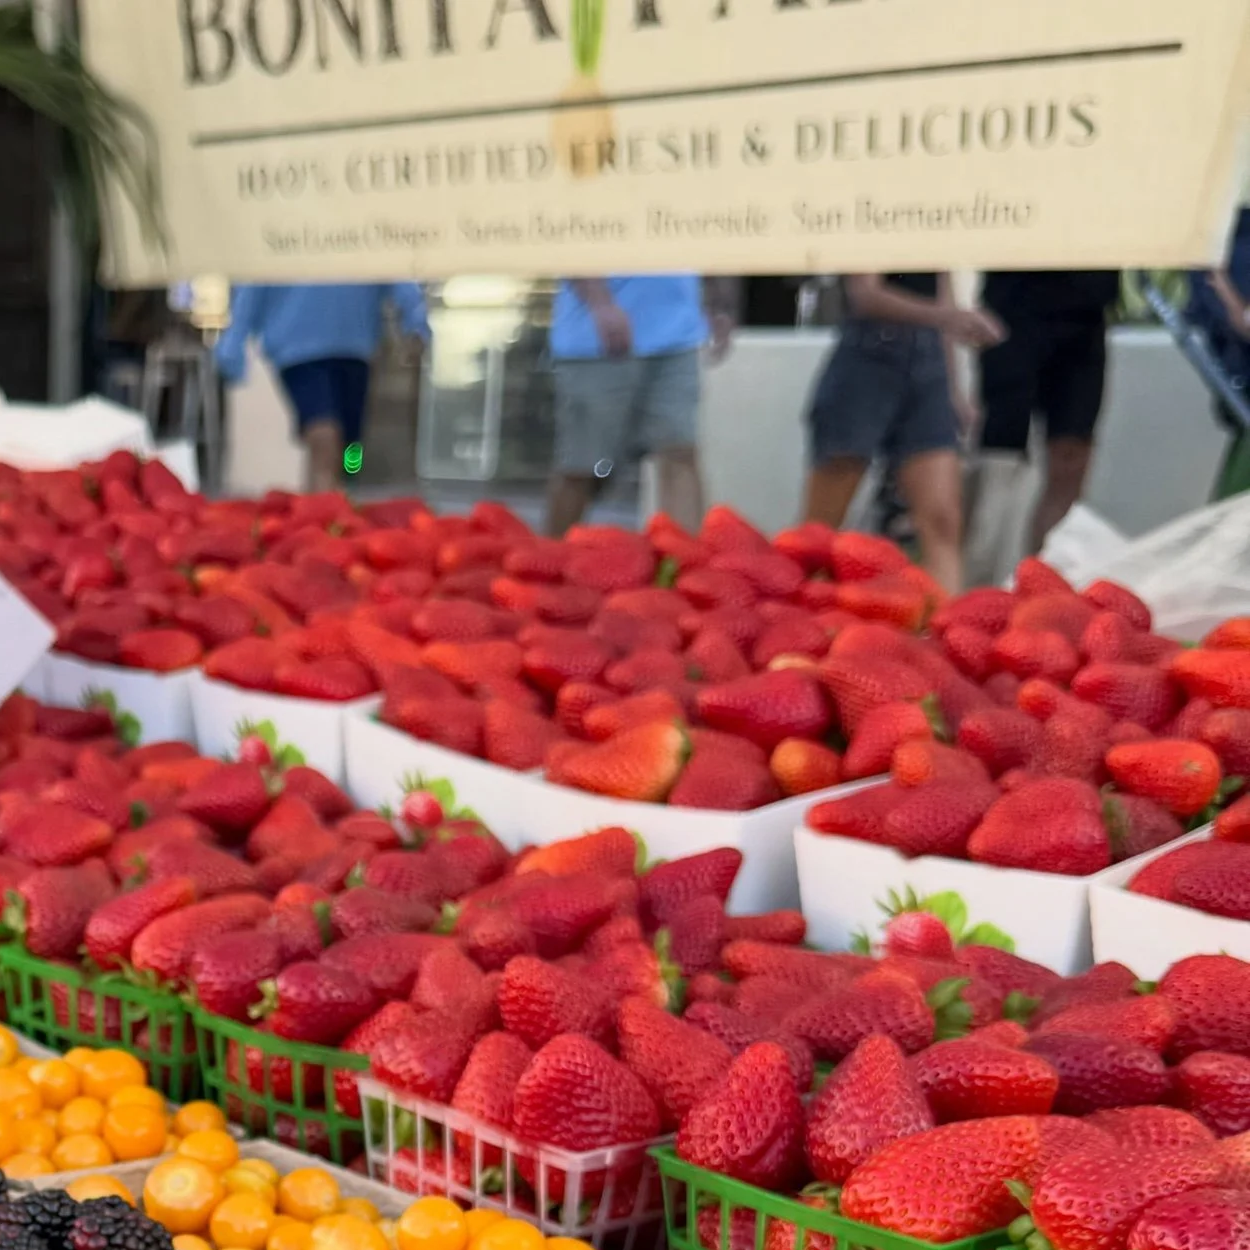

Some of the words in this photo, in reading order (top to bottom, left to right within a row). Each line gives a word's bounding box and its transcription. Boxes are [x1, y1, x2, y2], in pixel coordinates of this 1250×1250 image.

[344, 143, 554, 196] CERTIFIED
[569, 125, 722, 180] FRESH
[740, 120, 771, 166] &
[795, 95, 1100, 164] DELICIOUS
[646, 204, 770, 240] Riverside
[790, 198, 846, 234] San
[854, 190, 1038, 233] Bernardino
